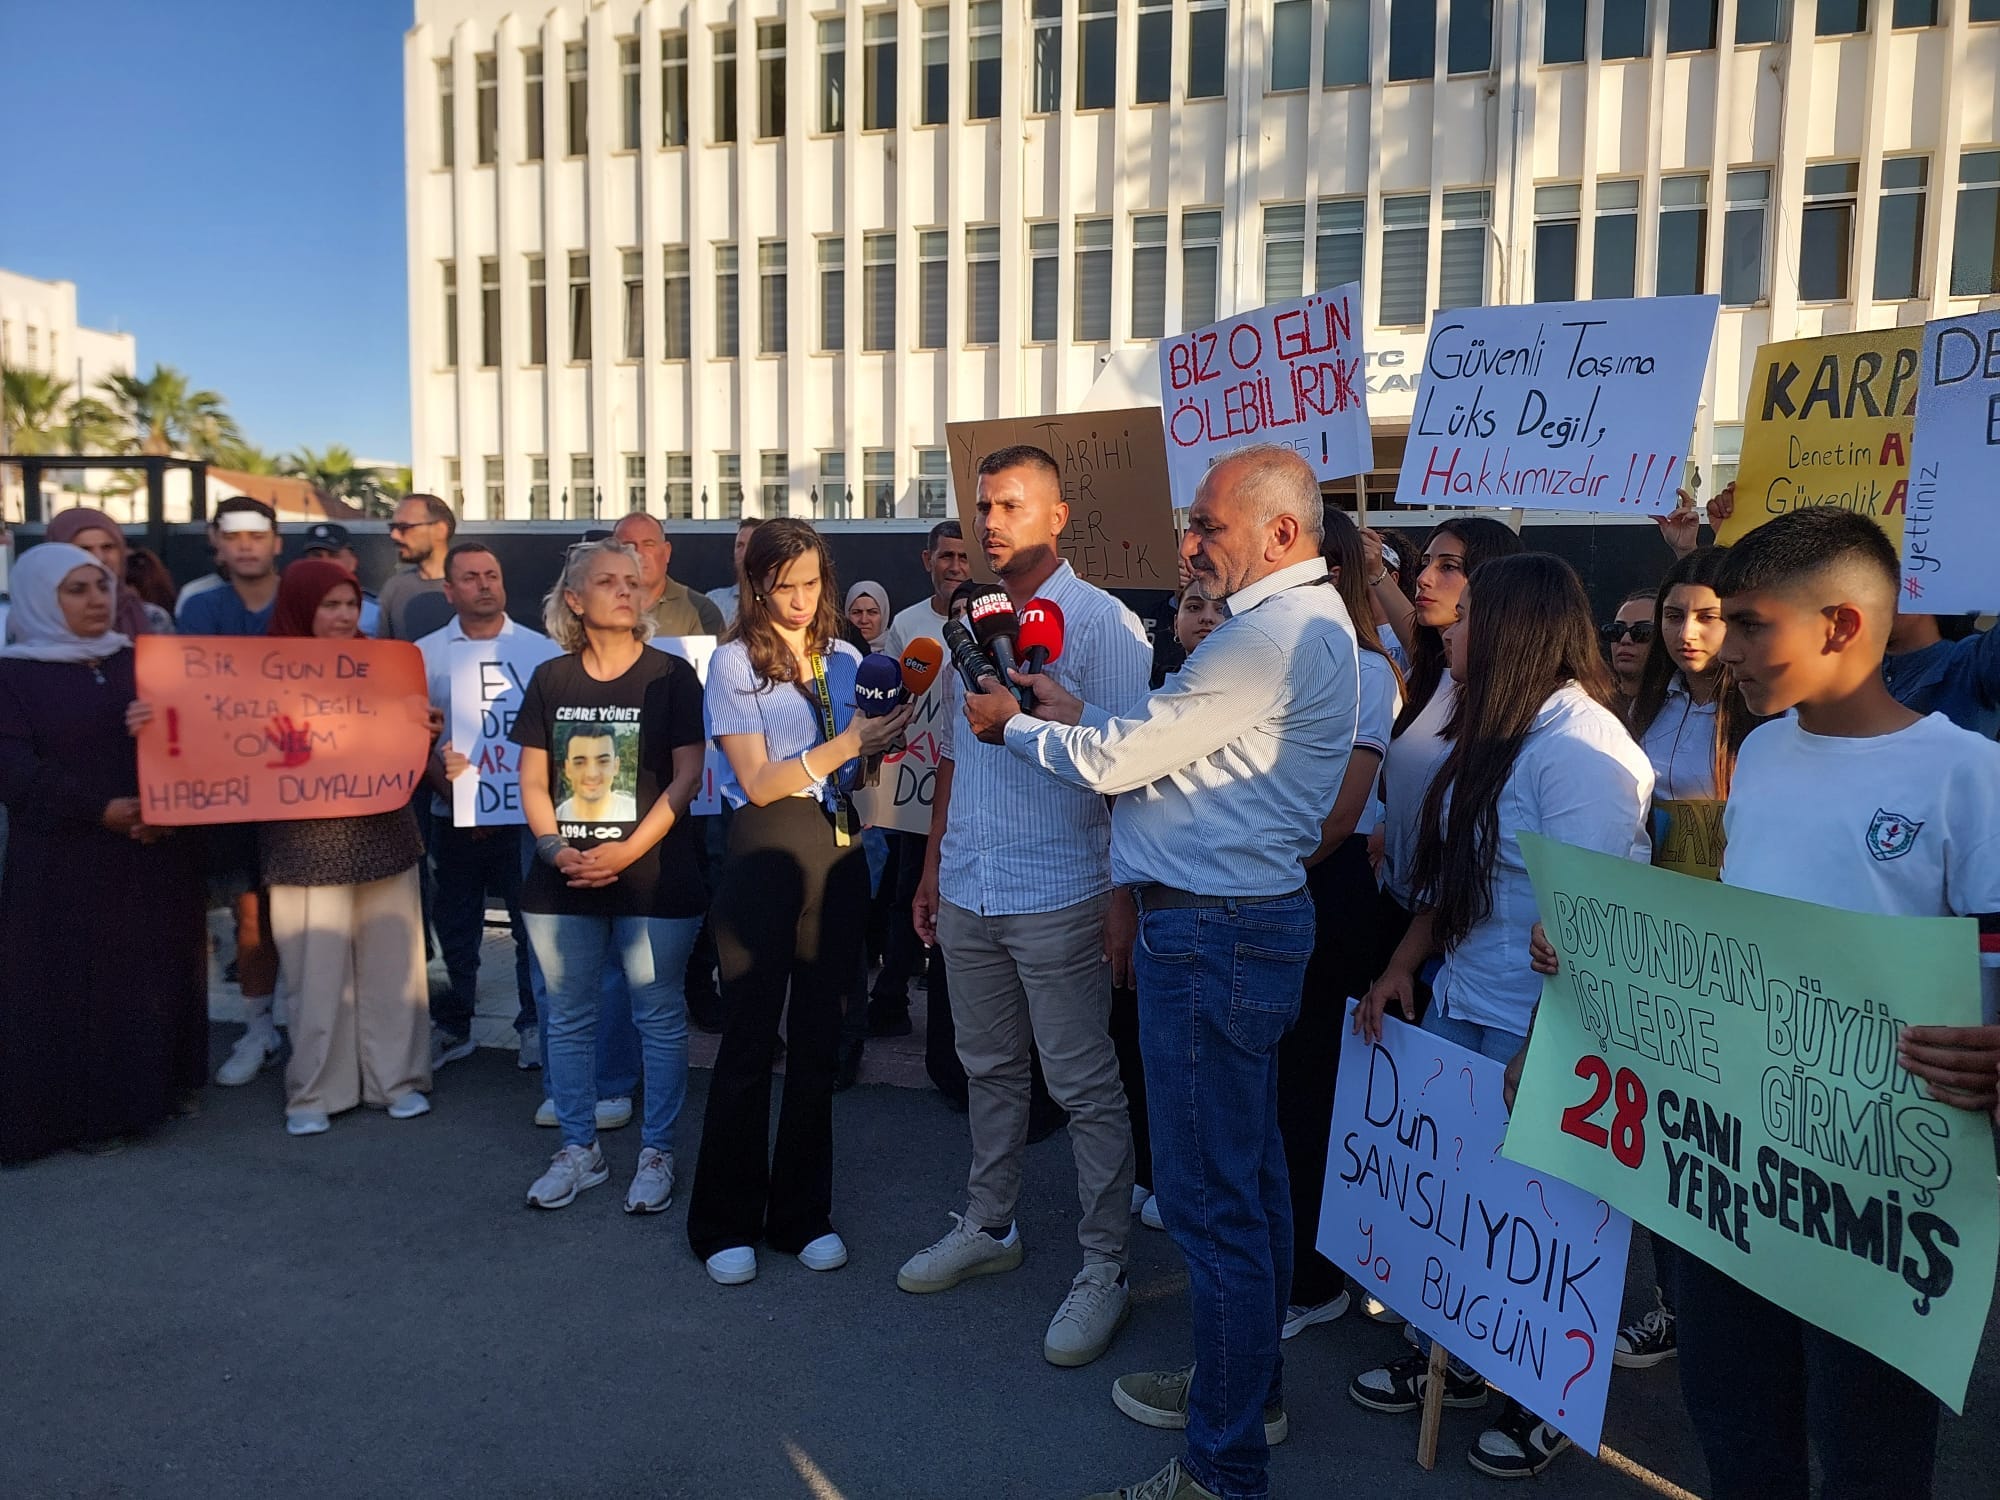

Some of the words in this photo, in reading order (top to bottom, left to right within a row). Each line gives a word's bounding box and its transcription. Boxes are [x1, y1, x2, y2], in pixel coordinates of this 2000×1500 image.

[1168, 331, 1222, 391] BİZ
[1228, 323, 1263, 370] O
[1273, 296, 1352, 361] GÜN
[1428, 322, 1546, 380] Güvenli
[1561, 320, 1656, 379] Taşıma
[1169, 348, 1362, 448] ÖLEBİLİRDİK
[1418, 384, 1497, 439] Lüks
[1760, 348, 1919, 421] KARP
[1420, 446, 1610, 498] Hakkımızdır
[1618, 452, 1678, 507] !!!
[1788, 435, 1871, 469] Denetim
[1878, 432, 1914, 467] A
[1903, 461, 1941, 600] #yettiniz
[971, 592, 1009, 610] KIBRIS
[971, 601, 1014, 619] GERÇEK
[181, 645, 239, 680] BİR
[335, 654, 371, 680] DE
[855, 683, 884, 700] myk
[555, 705, 597, 721] CEMRE
[598, 704, 641, 721] YÖNET
[476, 743, 524, 776] AR
[148, 776, 250, 812] HABERİ
[1553, 891, 1767, 1012] BOYUNDAN
[1364, 1042, 1438, 1161] Dün
[1560, 1054, 1649, 1170] 28
[1657, 1088, 1743, 1173] CANI
[1568, 959, 1721, 1085] İŞLERE
[1760, 1063, 1953, 1208] GİRMİŞ
[1339, 1131, 1602, 1334] ŞANSLIYDIK
[1662, 1139, 1752, 1255] YERE
[1752, 1144, 1961, 1317] SERMİŞ
[1356, 1216, 1392, 1284] ya
[1421, 1256, 1548, 1381] BUGÜN
